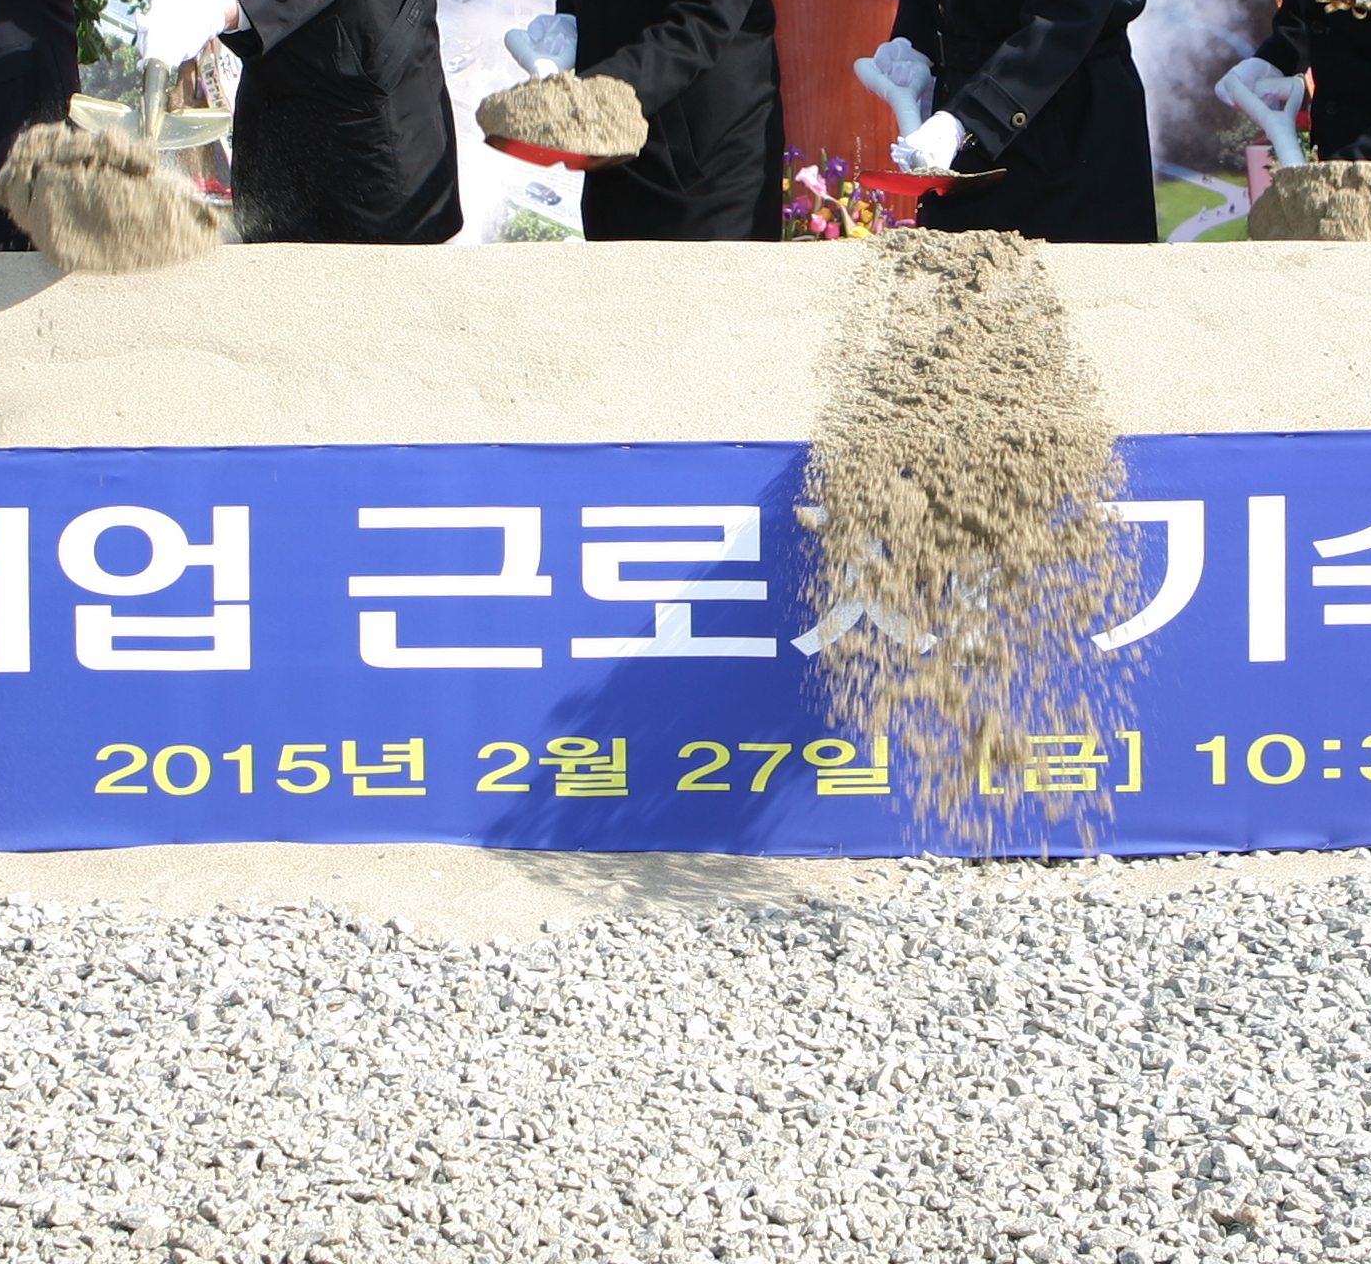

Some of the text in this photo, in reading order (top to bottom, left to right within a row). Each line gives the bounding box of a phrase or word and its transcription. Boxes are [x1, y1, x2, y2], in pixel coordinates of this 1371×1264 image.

[94, 737, 427, 797] 2015년
[476, 736, 630, 797] 2월
[676, 735, 892, 796] 27일
[978, 730, 1142, 796] [금]
